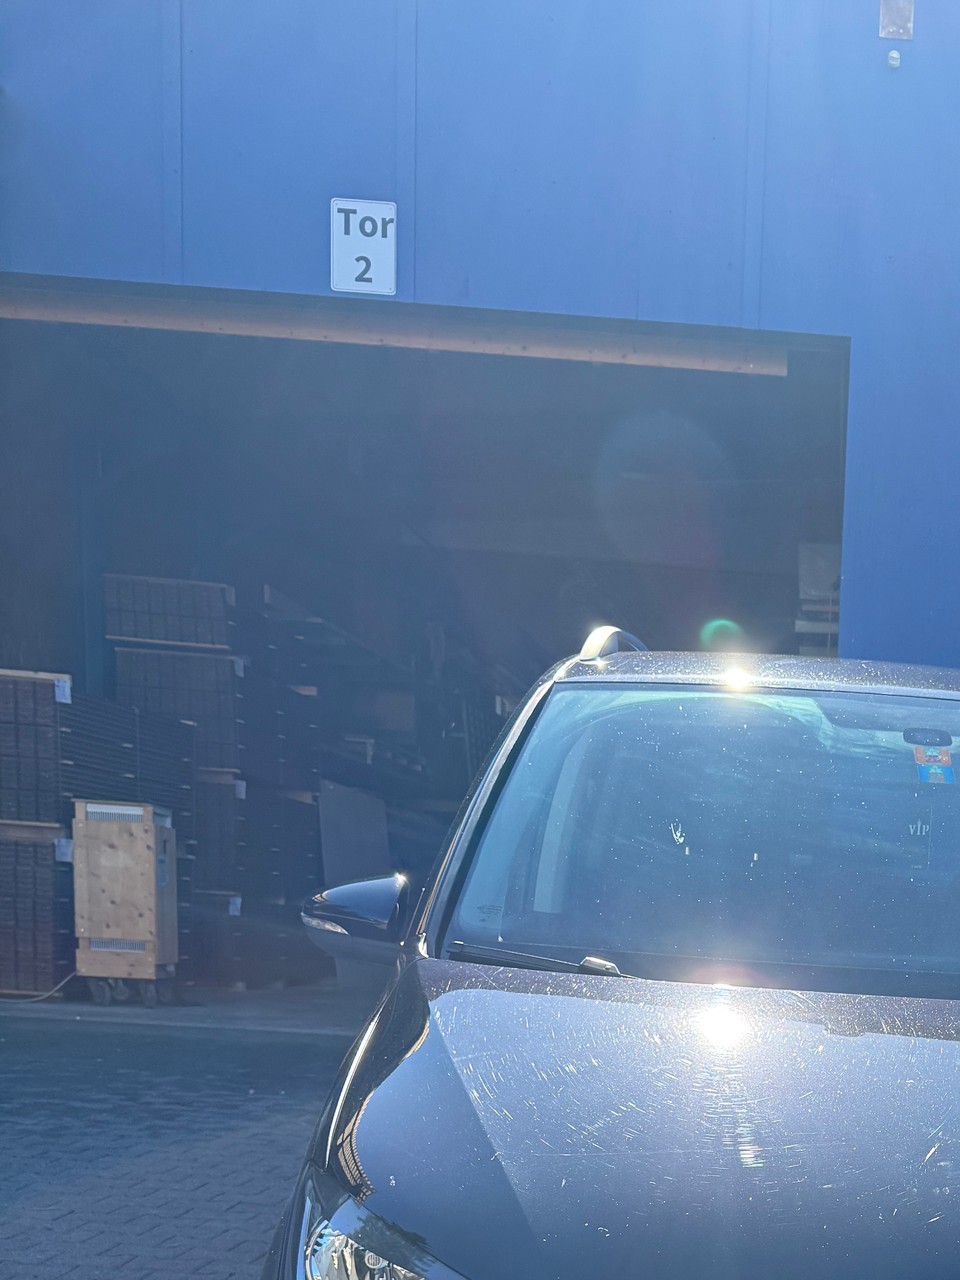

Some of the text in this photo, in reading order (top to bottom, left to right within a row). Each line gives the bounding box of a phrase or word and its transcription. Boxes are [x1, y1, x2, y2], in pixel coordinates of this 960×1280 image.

[336, 207, 395, 238] Tor
[354, 255, 373, 283] 2
[909, 818, 930, 836] VIP
